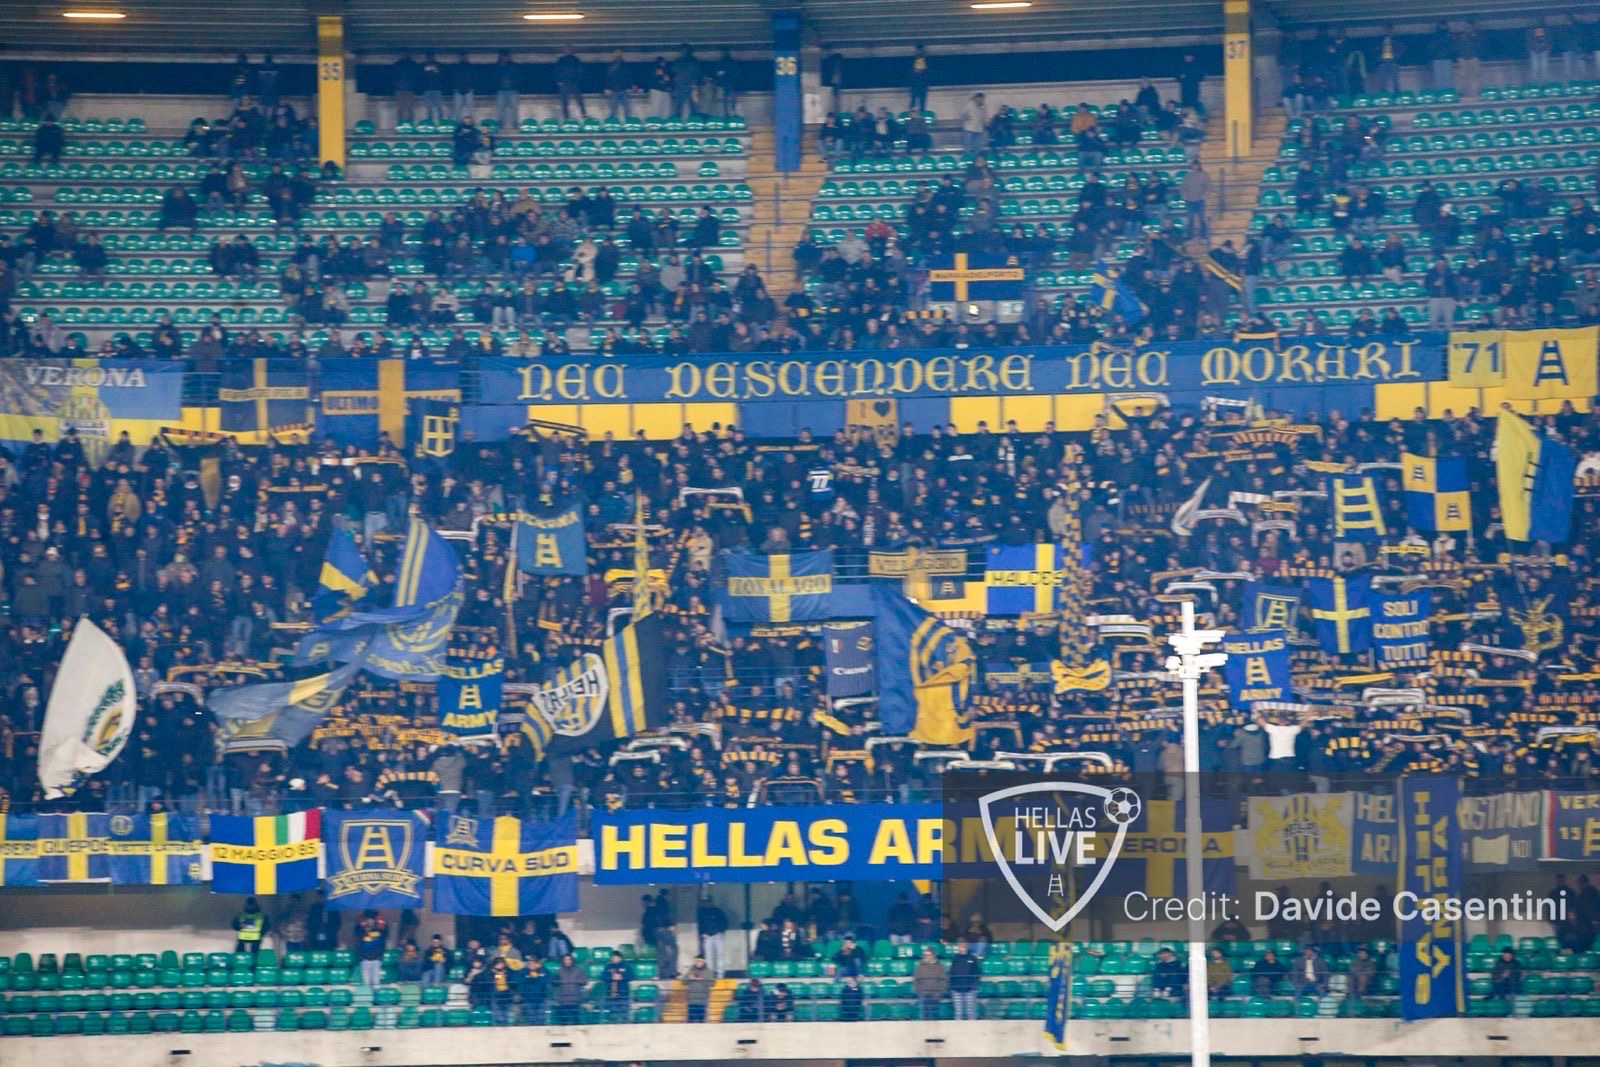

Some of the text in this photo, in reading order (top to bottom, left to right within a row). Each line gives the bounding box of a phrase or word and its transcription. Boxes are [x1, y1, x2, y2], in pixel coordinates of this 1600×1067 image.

[1228, 40, 1246, 59] 37
[322, 62, 339, 80] 35
[776, 57, 796, 75] 36
[24, 366, 147, 388] VERONA
[1223, 638, 1285, 654] HELLAS
[441, 709, 498, 728] ARMY
[214, 842, 316, 861] 12 MAGGIO 85
[600, 818, 850, 870] HELLAS
[442, 851, 569, 873] CURVA SUD
